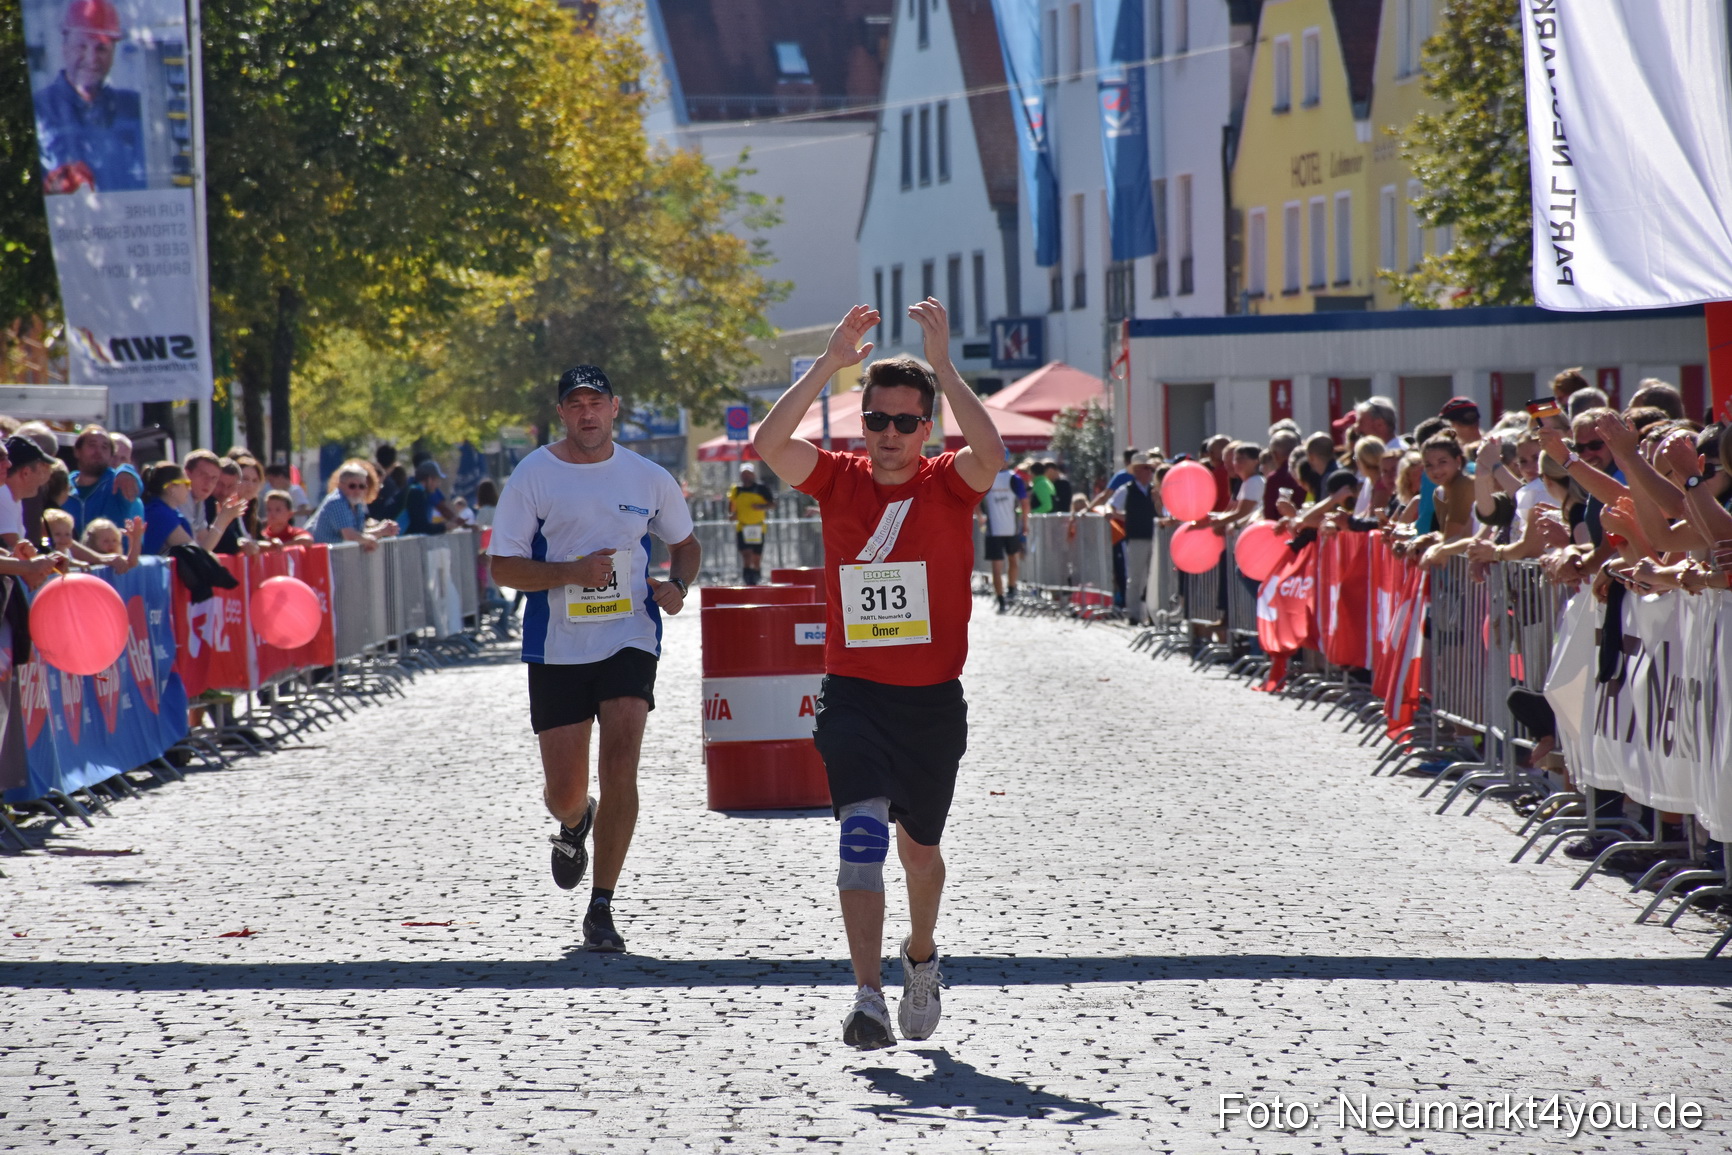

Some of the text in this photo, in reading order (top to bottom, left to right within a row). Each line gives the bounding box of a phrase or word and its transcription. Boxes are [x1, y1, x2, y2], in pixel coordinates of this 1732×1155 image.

[1291, 152, 1322, 188] HOTEL
[863, 570, 901, 580] BOCK
[860, 584, 908, 612] 313
[586, 602, 618, 614] Gerhard
[872, 623, 900, 637] Ömer
